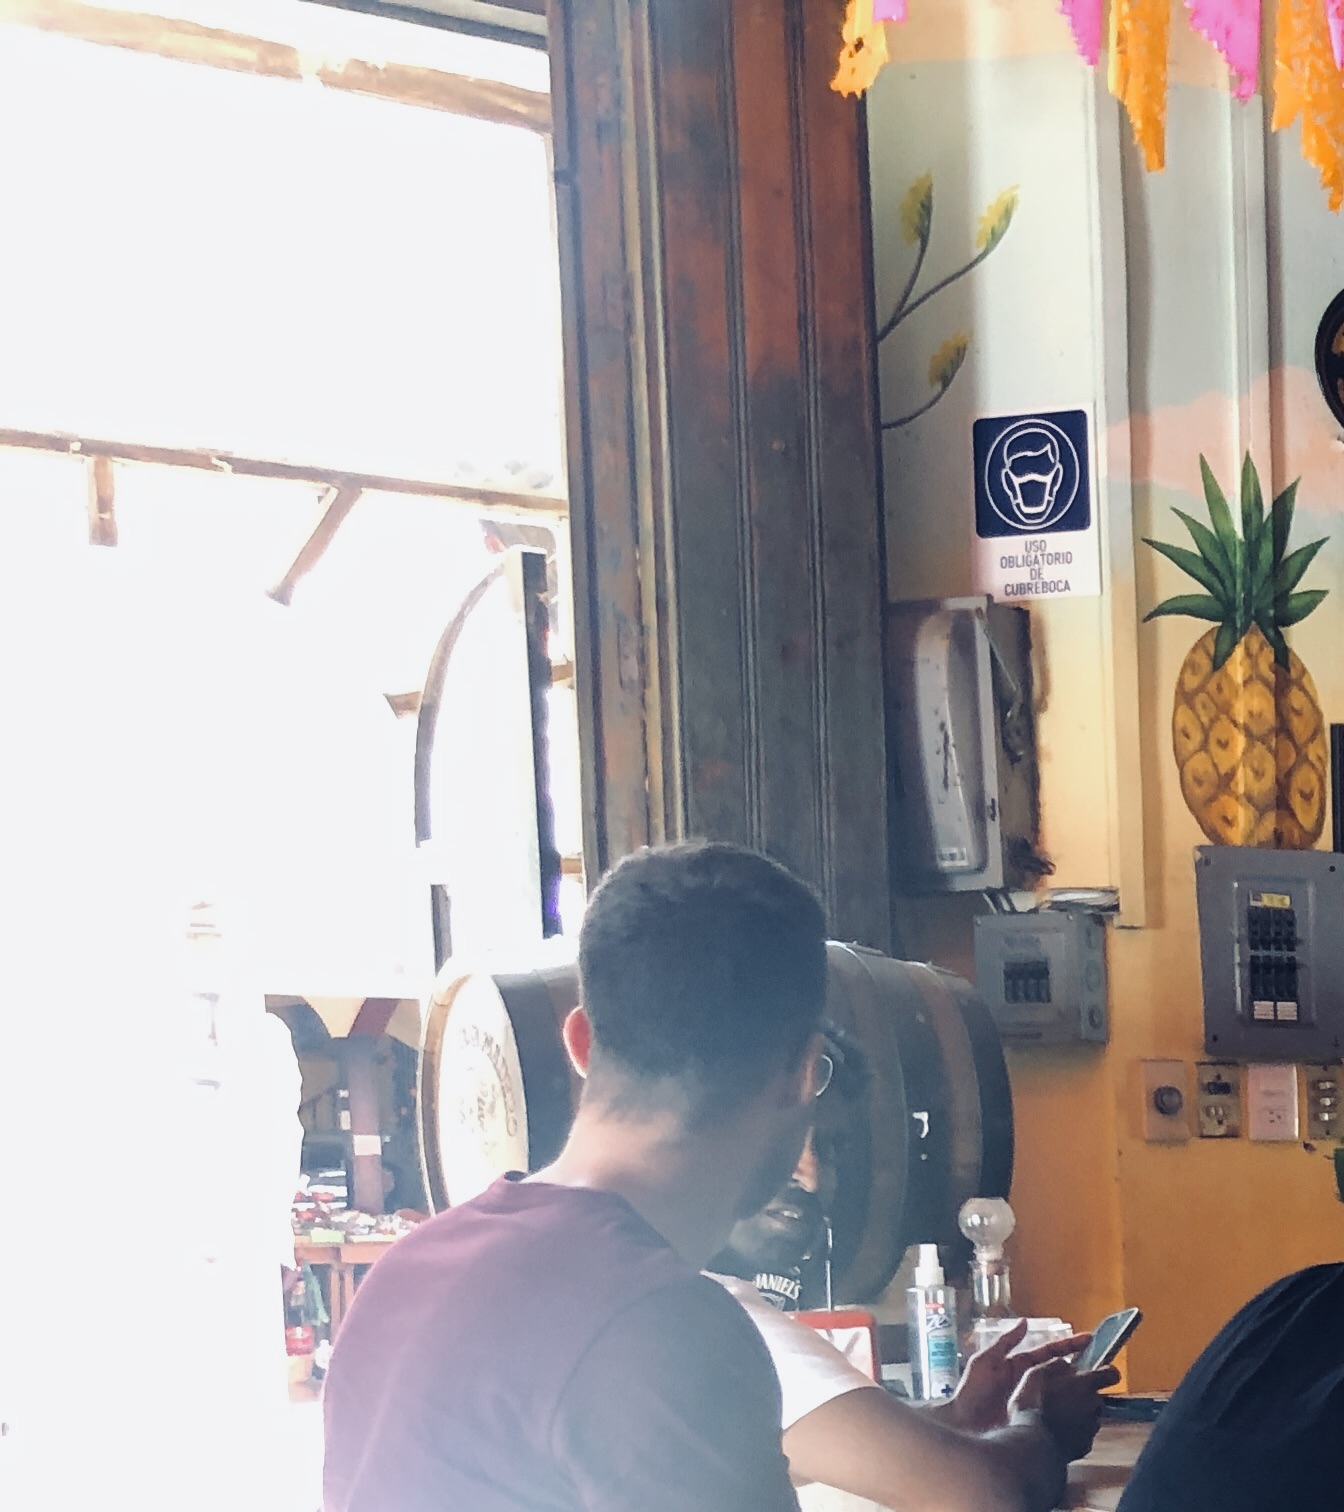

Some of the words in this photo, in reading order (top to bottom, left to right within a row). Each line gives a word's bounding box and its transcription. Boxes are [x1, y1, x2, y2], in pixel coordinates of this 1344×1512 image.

[1025, 540, 1047, 552] USO
[1000, 551, 1073, 569] OBLIGATORIO
[1030, 568, 1044, 580] DE
[1004, 580, 1071, 596] CUBREBOCA
